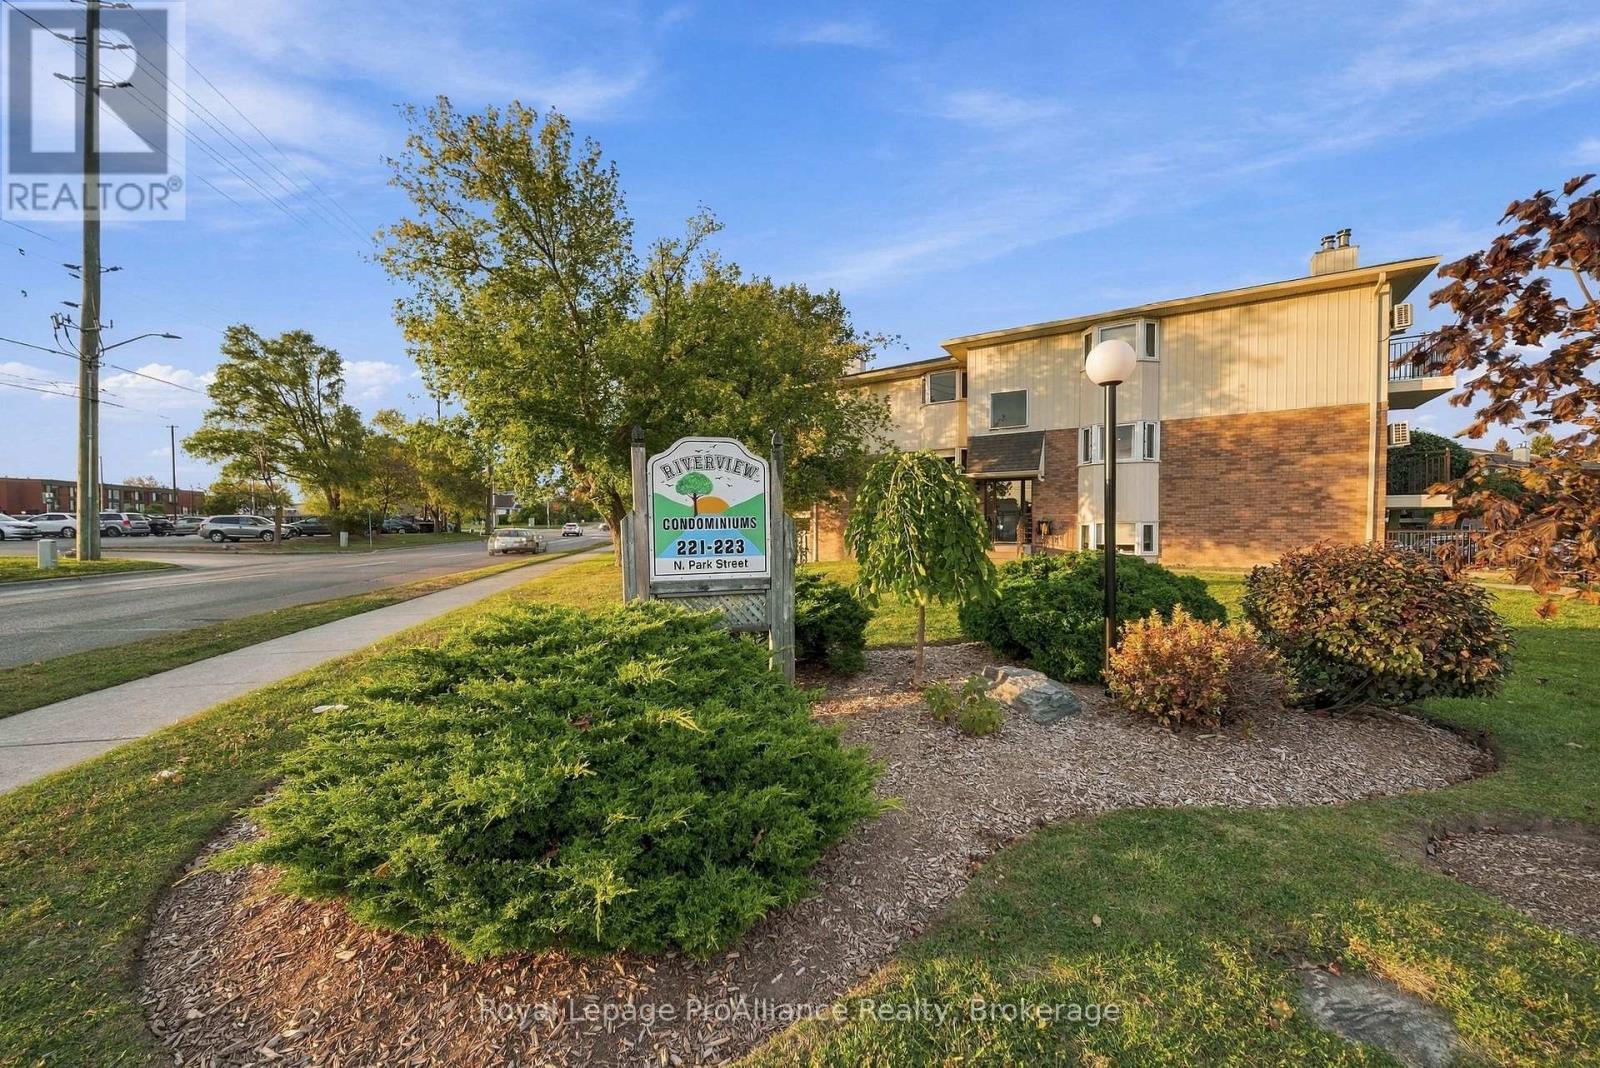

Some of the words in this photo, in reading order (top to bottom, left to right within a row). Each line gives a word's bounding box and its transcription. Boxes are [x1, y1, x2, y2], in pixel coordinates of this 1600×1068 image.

[660, 454, 760, 480] RIVERVIEW
[662, 517, 757, 530] CONDOMINIUMS
[677, 539, 745, 555] 221-223
[674, 561, 685, 570] N.
[688, 560, 713, 570] Park
[716, 558, 748, 569] Street
